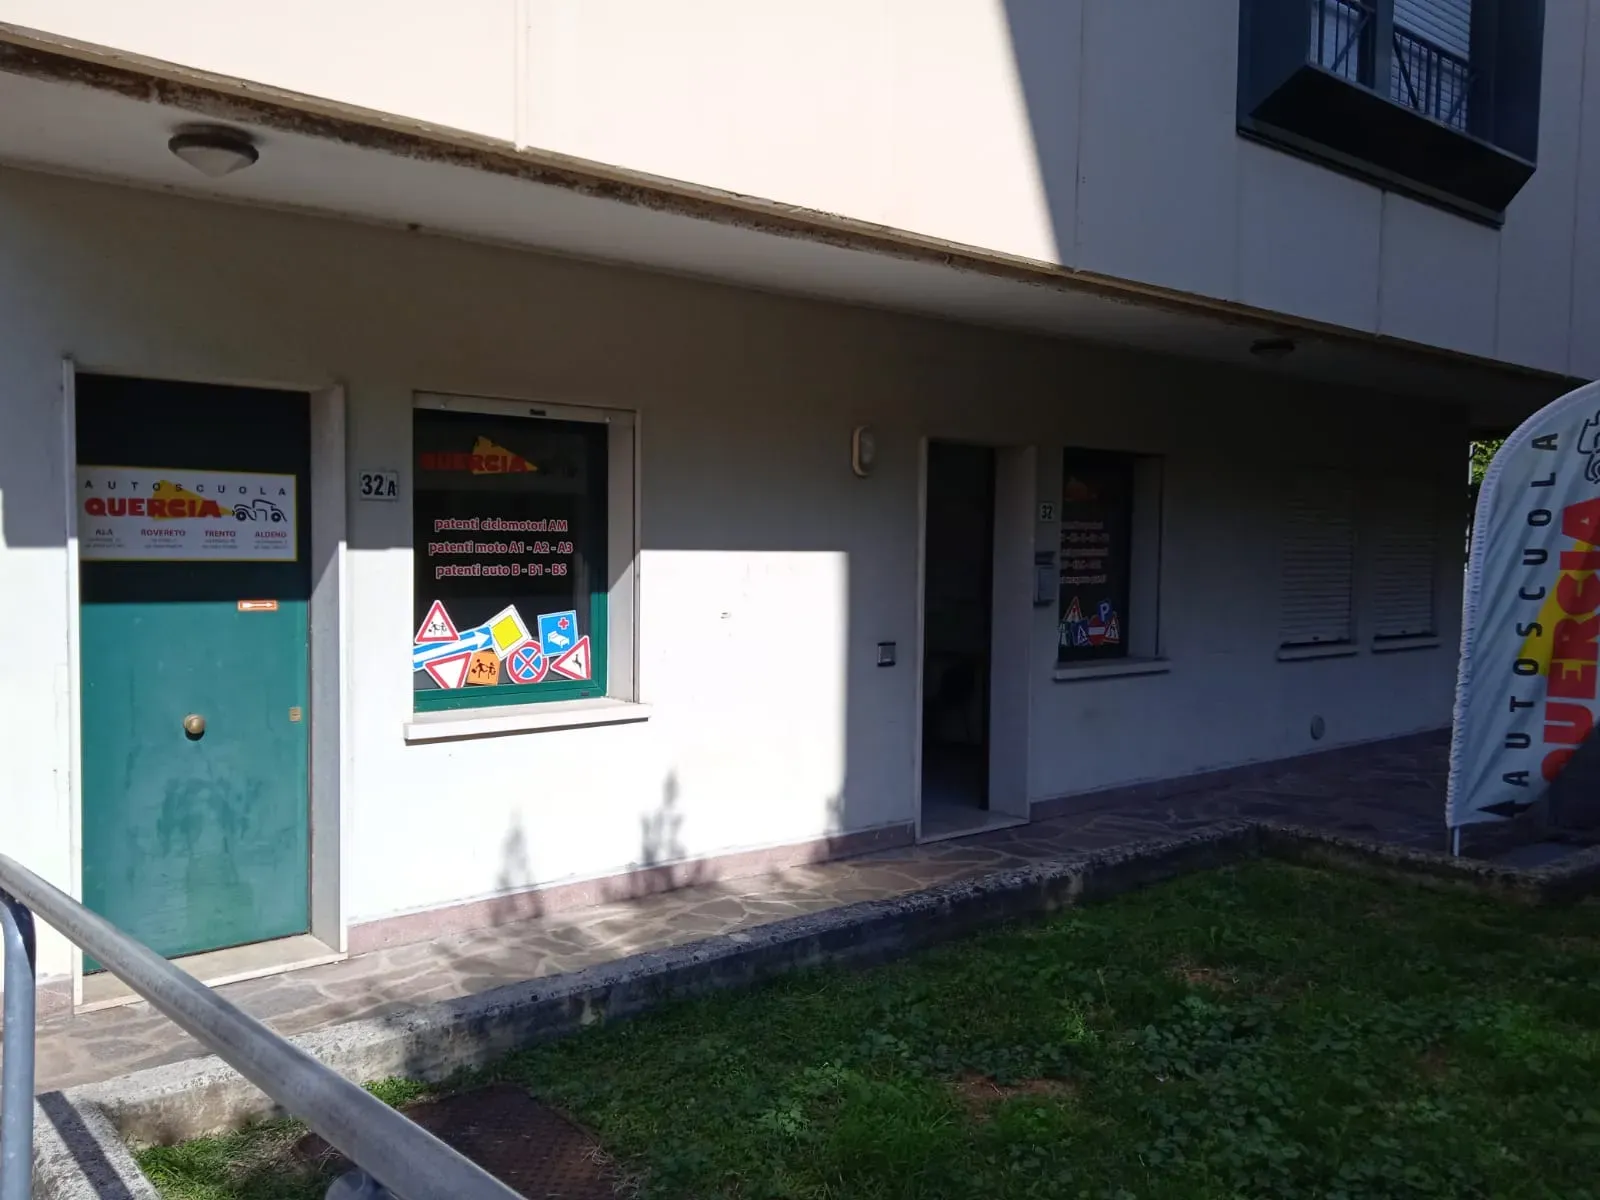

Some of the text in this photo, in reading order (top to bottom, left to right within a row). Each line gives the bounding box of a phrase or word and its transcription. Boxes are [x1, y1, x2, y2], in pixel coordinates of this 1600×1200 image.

[85, 480, 287, 496] AUTOSCUOLA
[85, 497, 222, 518] QUERCIA
[1041, 504, 1053, 519] 32
[141, 528, 186, 537] ROVERETO
[434, 517, 568, 532] patenti ciclomotori AM
[428, 541, 474, 556] patenti
[474, 542, 507, 553] moto
[508, 541, 525, 553] A1
[533, 541, 550, 553] A2
[557, 541, 573, 553] A3
[436, 564, 480, 579] patenti
[481, 565, 510, 576] auto
[511, 563, 521, 576] B
[528, 563, 543, 576] B1
[1100, 602, 1110, 621] P
[1502, 433, 1558, 788] AUTOSCUOLA
